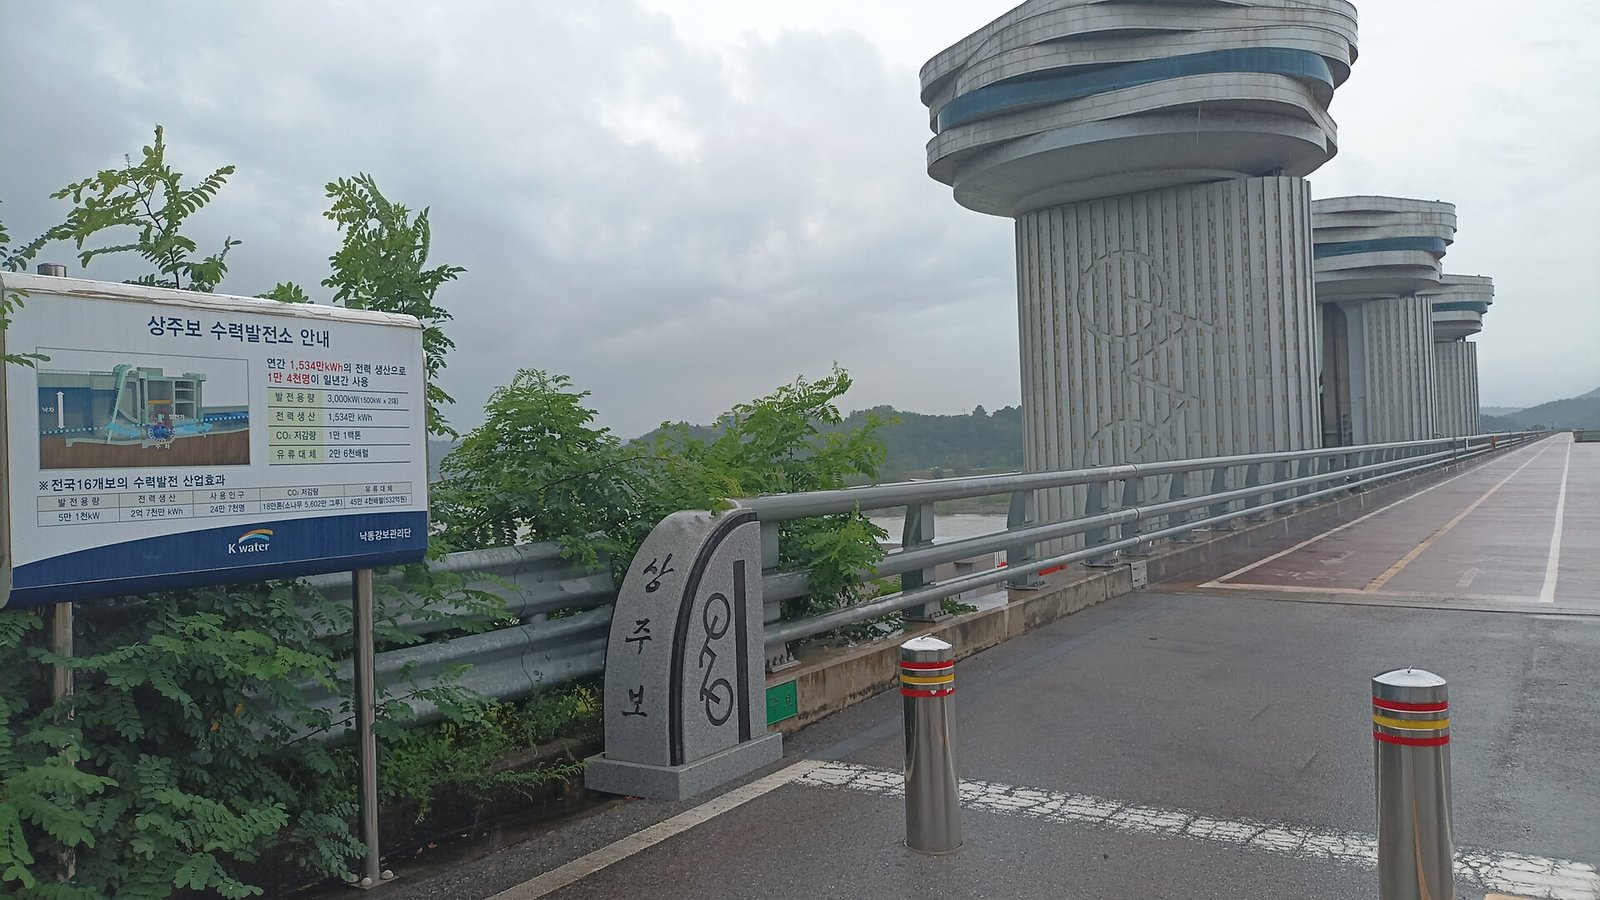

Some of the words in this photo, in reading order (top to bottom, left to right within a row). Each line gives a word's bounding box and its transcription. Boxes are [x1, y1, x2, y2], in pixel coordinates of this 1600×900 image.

[147, 315, 202, 337] 상주보
[210, 321, 294, 344] 수력발전소
[300, 328, 330, 348] 안내
[267, 358, 285, 370] 연간
[355, 363, 371, 375] 전력
[375, 364, 406, 376] 생산으로
[268, 372, 282, 383] 1만
[286, 373, 319, 385] 4천명이
[323, 375, 349, 386] 일년간
[352, 376, 368, 388] 사용
[328, 413, 355, 422] 1,534만
[358, 413, 372, 421] kWh
[294, 431, 316, 441] 저감량
[329, 431, 340, 440] 1만
[343, 431, 361, 440] 1백톤
[329, 450, 341, 459] 2만
[343, 449, 369, 458] 6천배럴
[51, 477, 128, 492] 전국16개보의
[133, 475, 178, 489] 수력발전
[183, 474, 226, 487] 산업효과
[301, 488, 319, 496] 저감량
[304, 500, 327, 510] 5,602만
[329, 498, 343, 508] 그루)
[350, 497, 363, 506] 45만
[130, 509, 143, 518] 2억
[146, 508, 165, 518] 7천만
[167, 507, 183, 516] kWh
[210, 505, 225, 514] 24만
[228, 504, 245, 513] 7천명
[58, 513, 71, 522] 5만
[75, 511, 100, 521] 1천kW
[228, 543, 236, 554] K
[238, 542, 270, 553] water
